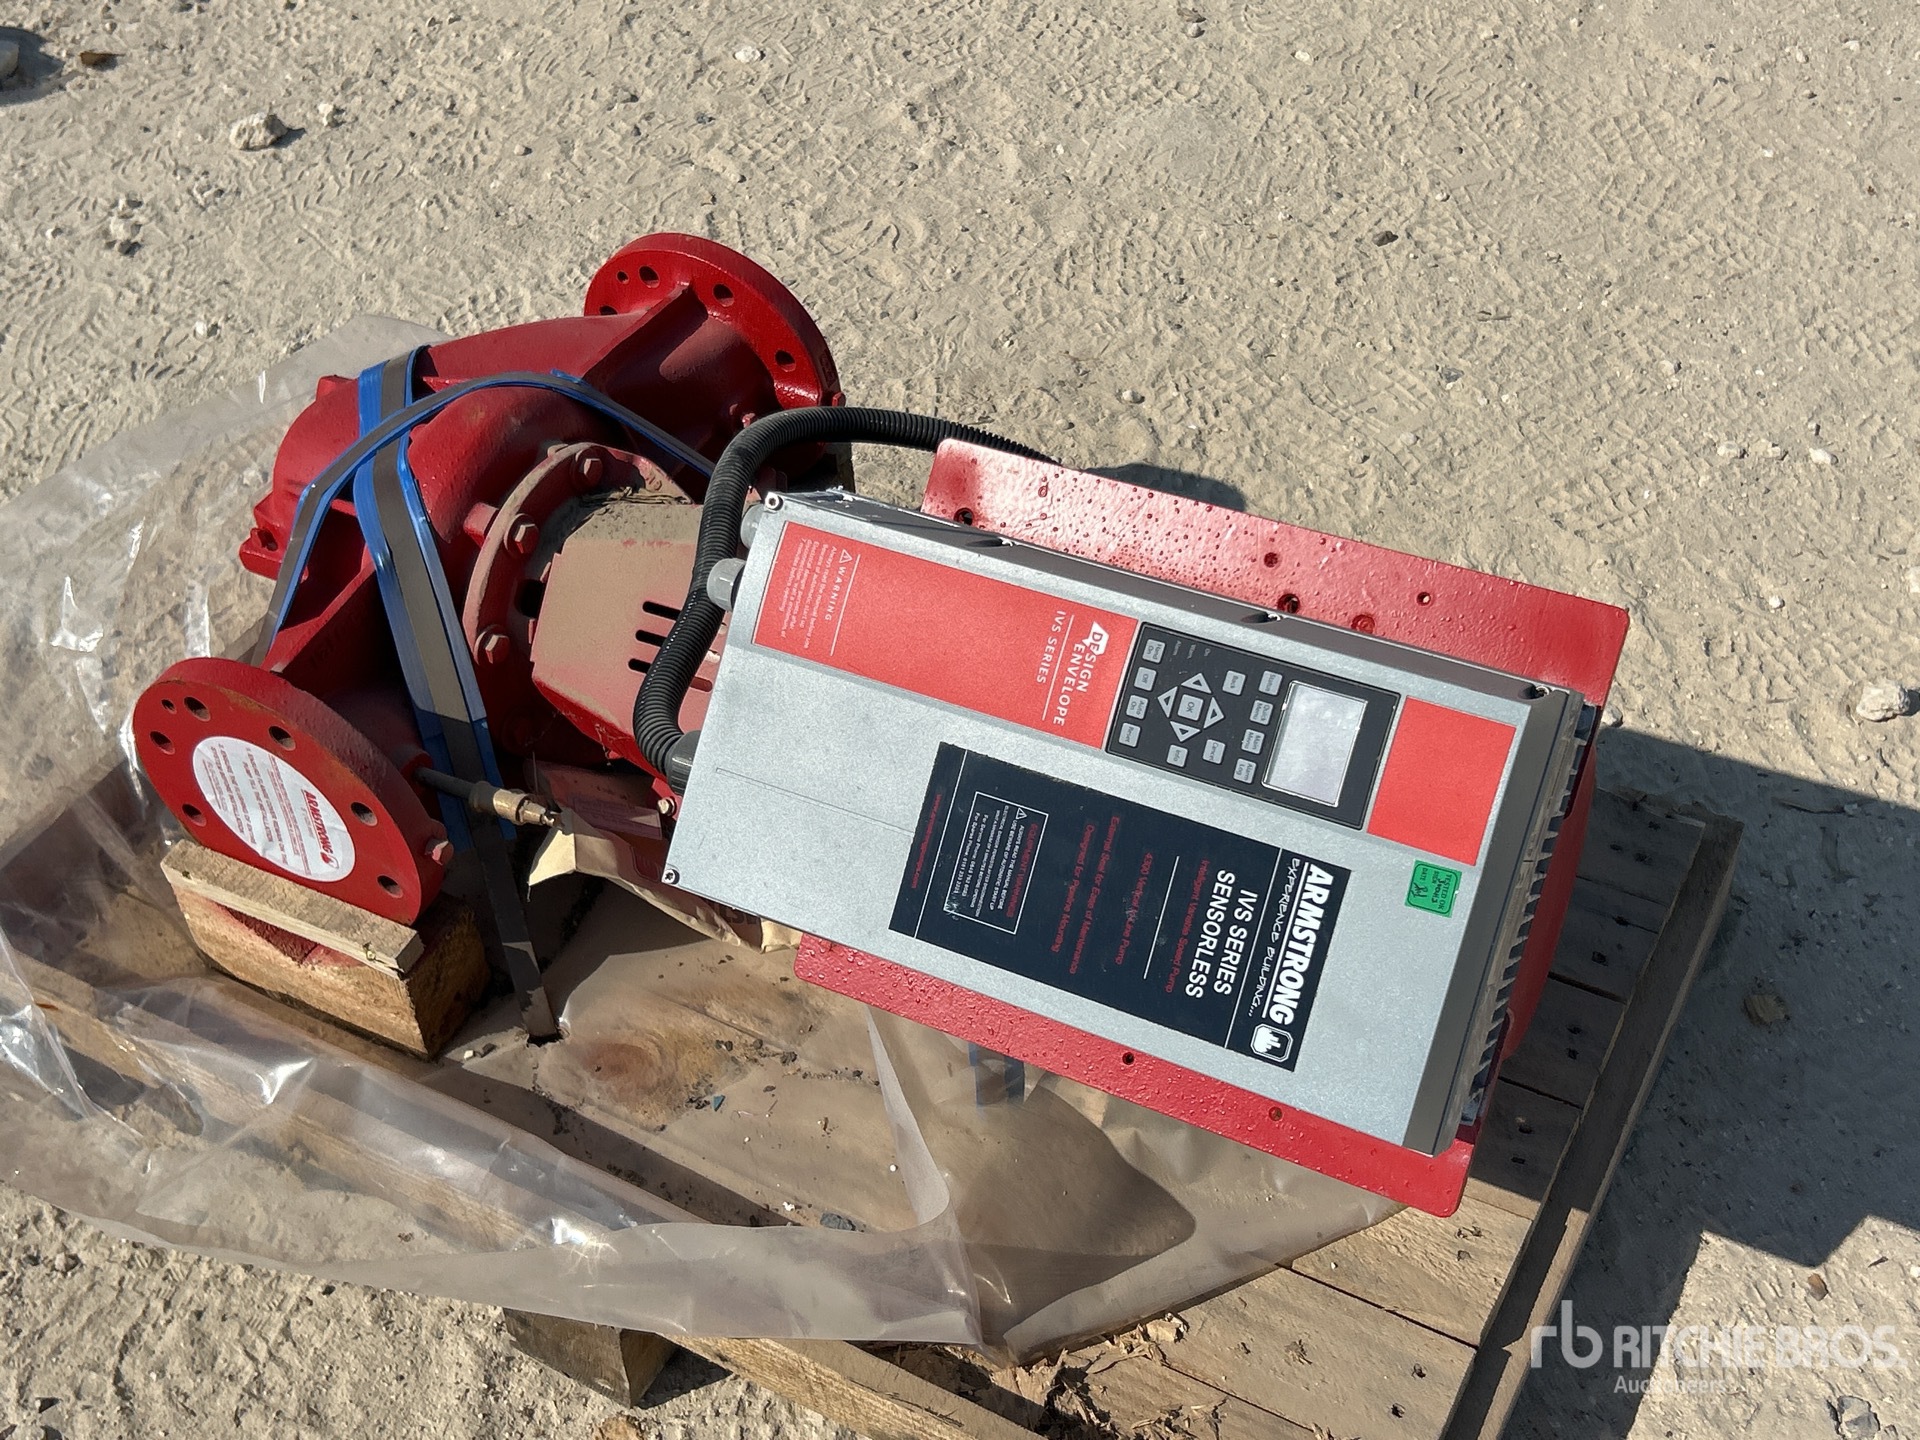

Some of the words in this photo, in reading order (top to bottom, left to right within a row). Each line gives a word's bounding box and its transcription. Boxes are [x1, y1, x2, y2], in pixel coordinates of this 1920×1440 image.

[805, 540, 819, 569] Electrical
[816, 543, 828, 566] Beware
[825, 545, 837, 568] Always
[786, 566, 797, 586] before
[798, 568, 810, 590] danger
[814, 565, 821, 573] of
[821, 568, 830, 583] read
[778, 586, 791, 612] opening
[790, 582, 799, 596] wait
[805, 573, 819, 604] automatic
[818, 583, 826, 594] the
[824, 565, 846, 621] WARNING
[801, 604, 810, 619] start
[811, 594, 823, 617] manual
[798, 619, 805, 628] up
[805, 617, 817, 637] before
[1050, 609, 1066, 633] IVS
[802, 637, 810, 648] use
[1146, 644, 1153, 655] On
[1152, 643, 1162, 660] Hand
[1172, 639, 1181, 656] Alarm
[1203, 647, 1210, 657] On
[1035, 635, 1058, 684] SERIES
[1075, 630, 1103, 692] DESIGN
[1051, 642, 1086, 726] ENVELOPE
[1229, 674, 1238, 689] Back
[1264, 673, 1275, 692] Status
[1129, 700, 1137, 710] On
[1135, 699, 1145, 715] Auto
[1185, 700, 1194, 713] OK
[1252, 702, 1262, 720] Menu
[1259, 704, 1269, 721] Quick
[1124, 725, 1134, 742] Reset
[1244, 731, 1254, 749] Menu
[1251, 734, 1260, 750] Main
[1172, 748, 1181, 762] Info
[1208, 741, 1219, 761] Cancel
[1235, 763, 1245, 775] Log
[1243, 763, 1252, 779] Alarm
[304, 789, 333, 855] ARMSTRONG
[998, 804, 1009, 830] ELECTRICAL
[1010, 819, 1018, 830] USE
[968, 820, 978, 840] Spares
[975, 823, 986, 843] Service
[1004, 830, 1015, 851] BEWARE
[1014, 824, 1025, 845] ALWAYS
[1102, 815, 1119, 852] External
[1002, 850, 1009, 859] OF
[1011, 844, 1019, 859] READ
[1017, 822, 1039, 872] EQUIPMENT
[1074, 823, 1094, 865] Designed
[994, 858, 1007, 886] AUTOMATIC
[1072, 864, 1083, 878] for
[1096, 851, 1109, 874] Seal
[1139, 851, 1154, 875] 4300
[1002, 868, 1012, 889] MANUAL
[1092, 872, 1103, 886] for
[1188, 858, 1209, 900] Intelligent
[1419, 867, 1428, 880] DATE
[990, 886, 999, 902] START
[1005, 871, 1025, 918] WARNINGS
[1062, 877, 1079, 912] Pipeline
[1130, 875, 1147, 908] Vertical
[1440, 873, 1452, 899] TESTED
[987, 901, 995, 910] UP
[996, 888, 1007, 910] BEFORE
[1086, 886, 1100, 909] Ease
[1232, 888, 1258, 923] IVS
[1267, 856, 1301, 944] EXPERIENCE
[1437, 898, 1445, 910] OK
[1082, 909, 1093, 920] of
[1180, 901, 1197, 936] Variable
[1050, 912, 1069, 953] Mounting
[1183, 868, 1236, 999] SENSORLESS
[1067, 919, 1090, 975] Maintenance
[1113, 937, 1130, 966] Pump
[1170, 935, 1187, 966] Speed
[1266, 862, 1335, 1028] ARMSTRONG
[1212, 923, 1248, 996] SERIES
[1162, 965, 1179, 994] Pump
[1247, 945, 1276, 1018] BUILDING...
